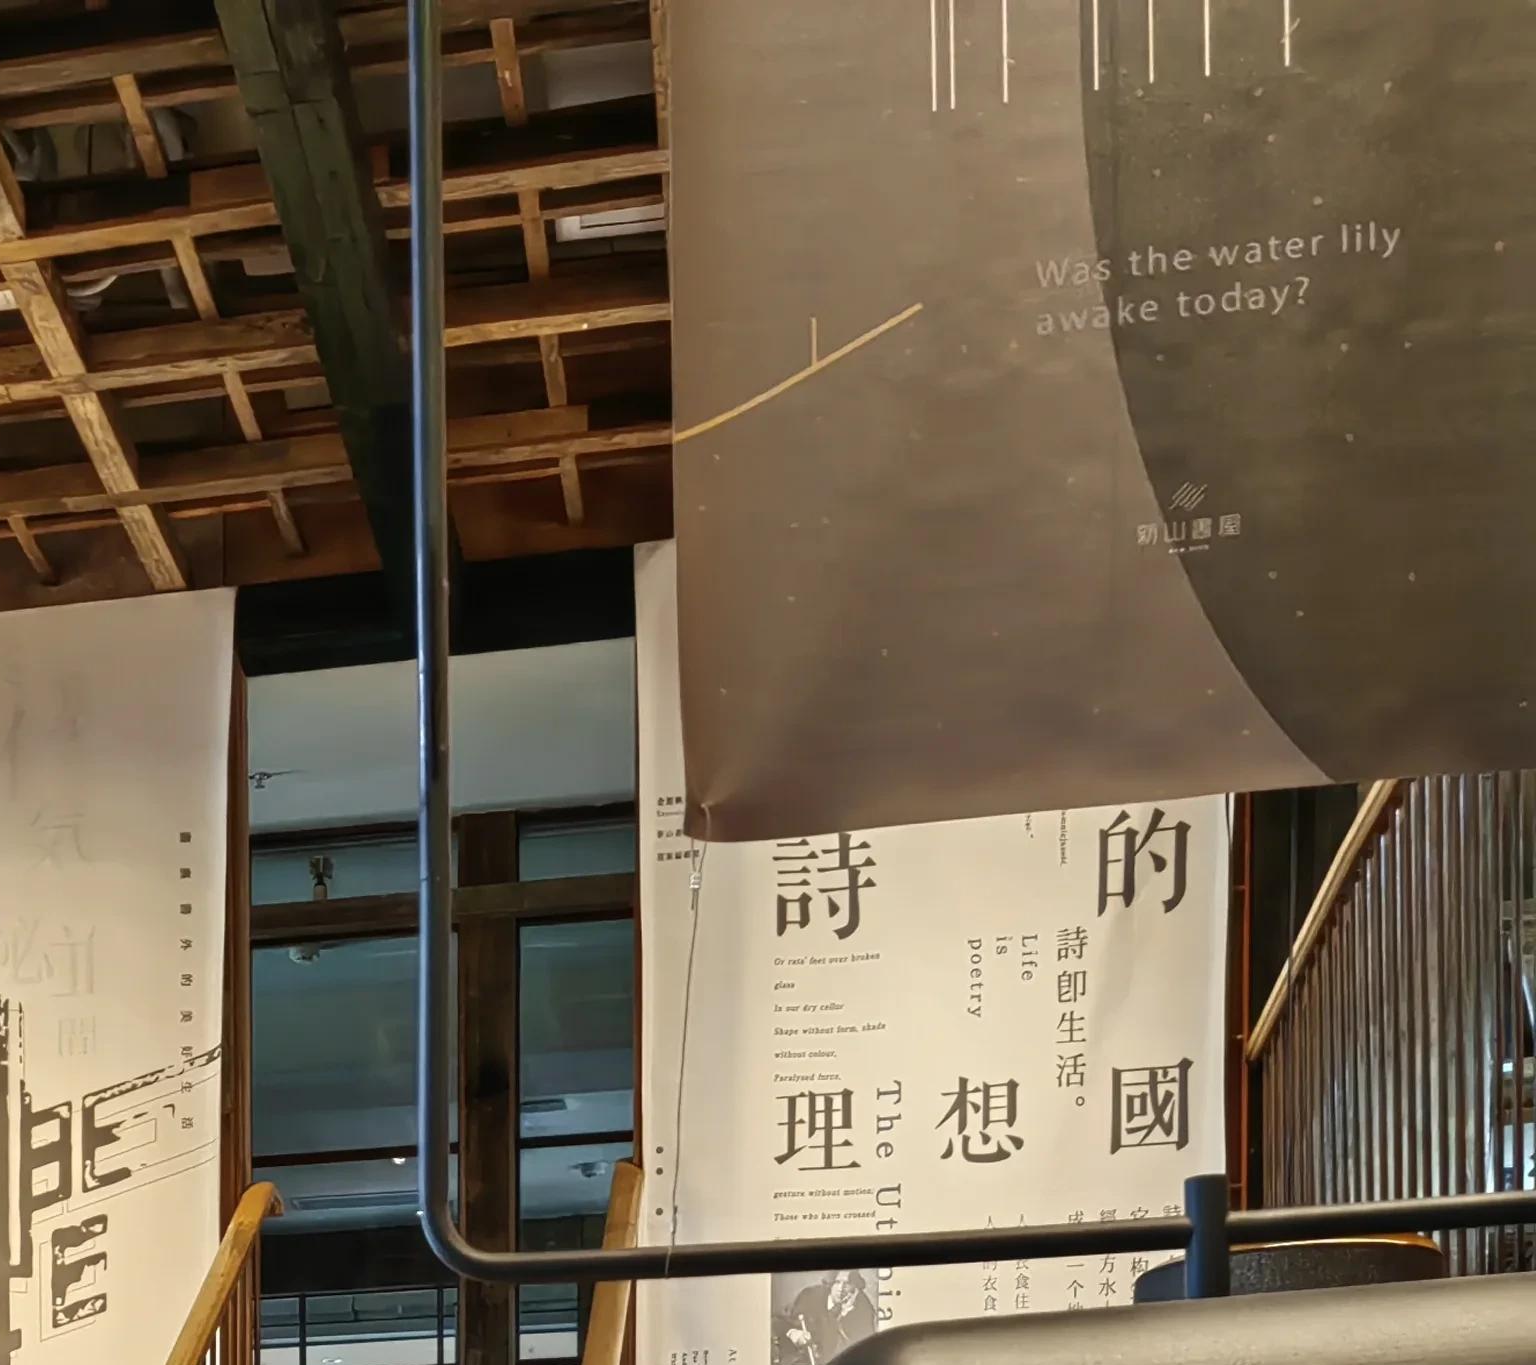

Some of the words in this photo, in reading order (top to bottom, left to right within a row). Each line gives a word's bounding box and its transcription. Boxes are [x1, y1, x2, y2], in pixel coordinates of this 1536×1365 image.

[1035, 257, 1112, 289] Was
[1128, 245, 1194, 278] the
[1209, 232, 1325, 269] water
[1340, 221, 1402, 260] lily
[1035, 296, 1160, 337] awake
[1176, 276, 1312, 318] today?
[772, 831, 878, 940] 詩
[1096, 806, 1193, 918] 的
[968, 937, 984, 1019] poetry
[996, 935, 1014, 956] is
[1020, 932, 1039, 983] Life
[874, 1079, 902, 1160] The
